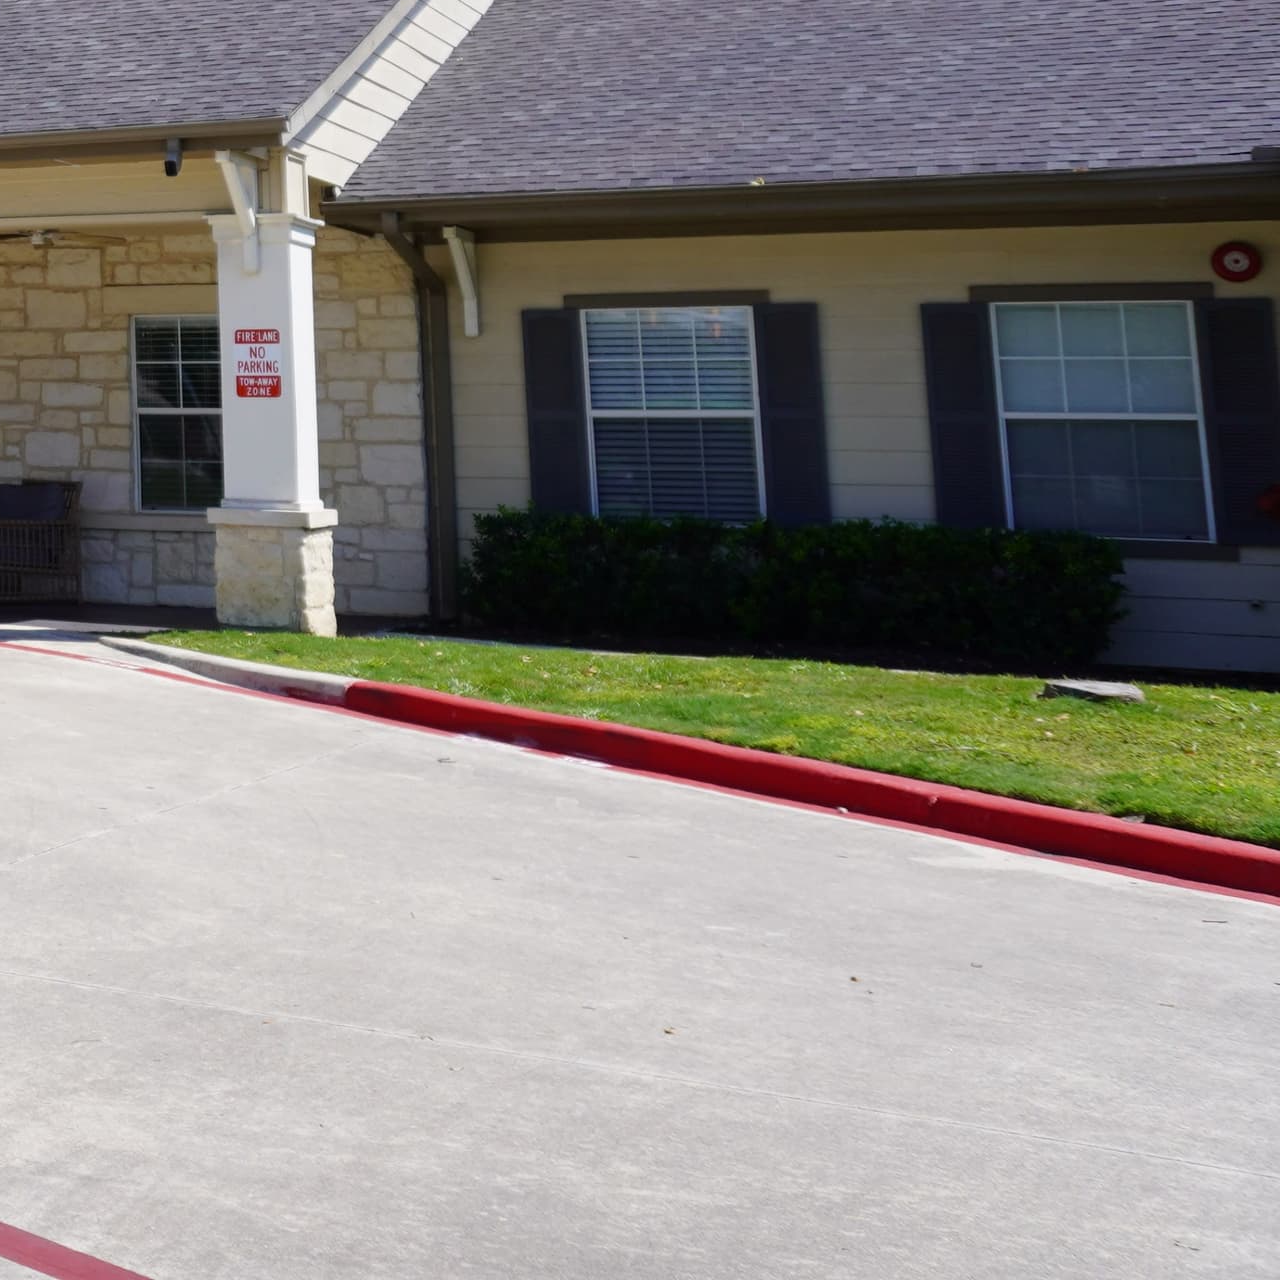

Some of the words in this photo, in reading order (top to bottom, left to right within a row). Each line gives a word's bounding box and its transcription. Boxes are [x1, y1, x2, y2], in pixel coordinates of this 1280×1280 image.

[236, 331, 256, 342] FIRE
[258, 331, 278, 342] LANE
[249, 346, 266, 359] NO
[237, 361, 279, 373] PARKING
[246, 386, 272, 396] ZONE
